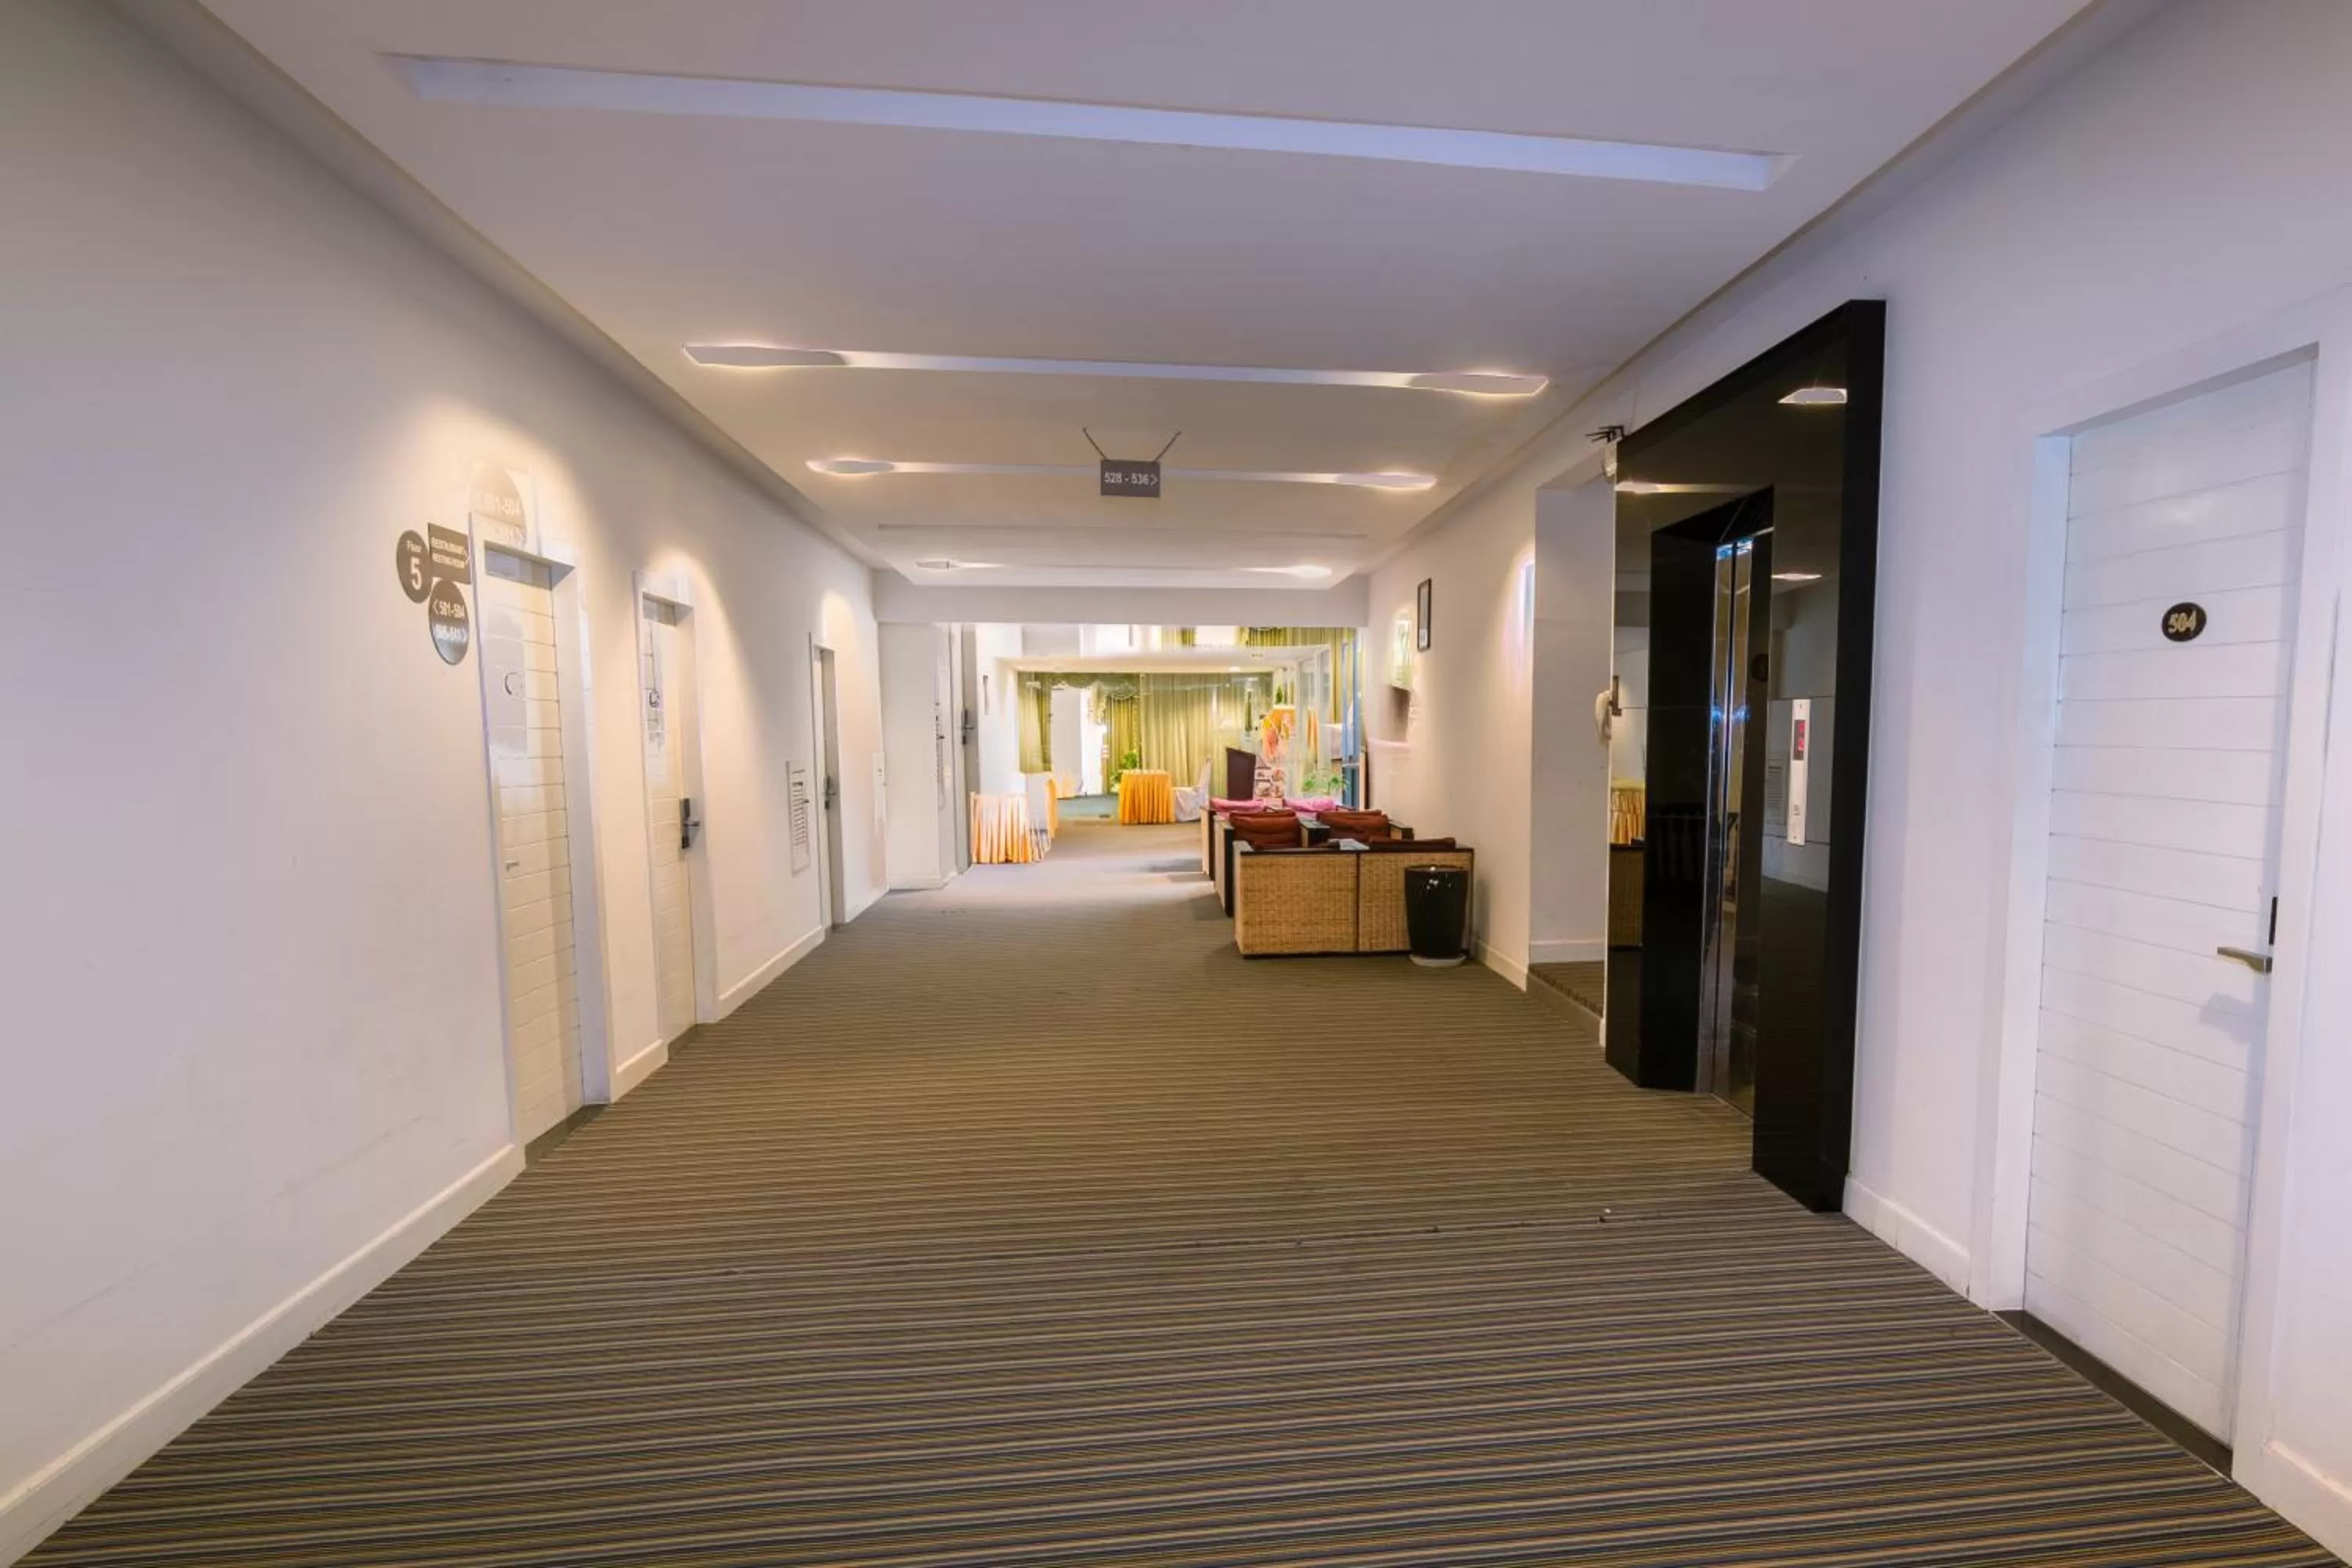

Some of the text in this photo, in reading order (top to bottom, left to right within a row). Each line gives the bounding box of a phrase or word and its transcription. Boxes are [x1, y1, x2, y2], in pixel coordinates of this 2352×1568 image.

[1104, 472, 1122, 484] 528
[410, 556, 423, 590] 5
[2168, 609, 2197, 634] 504
